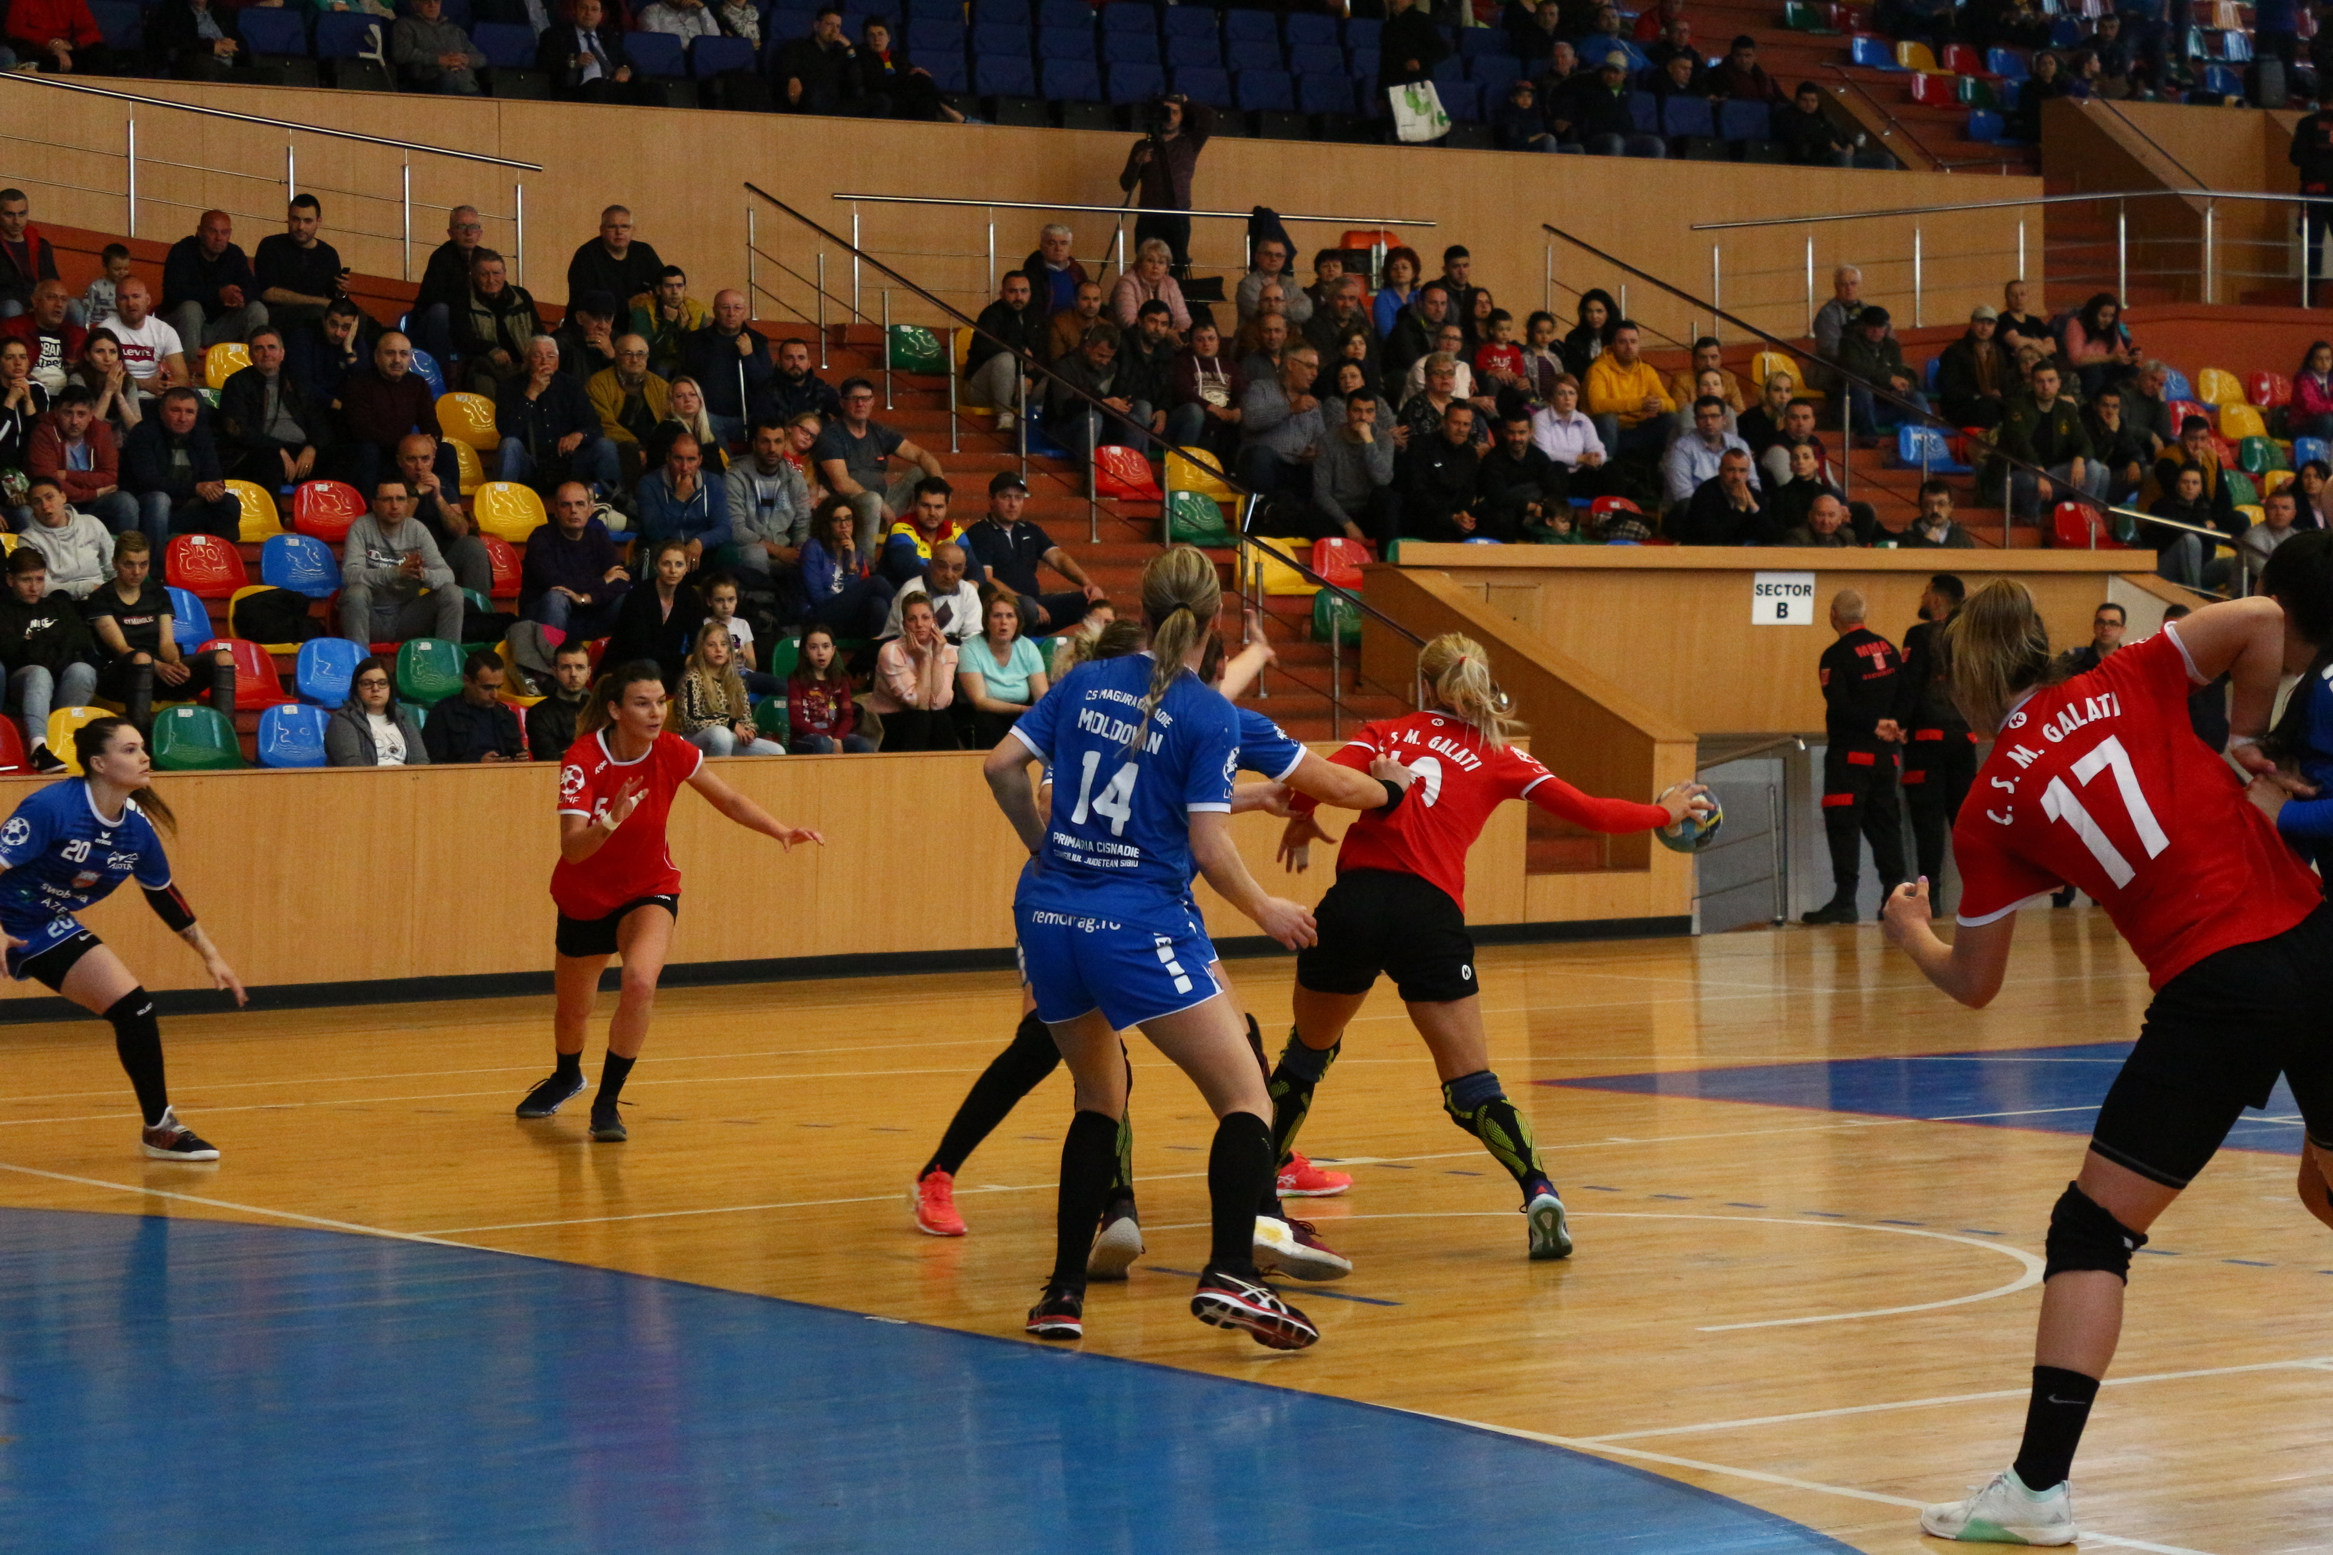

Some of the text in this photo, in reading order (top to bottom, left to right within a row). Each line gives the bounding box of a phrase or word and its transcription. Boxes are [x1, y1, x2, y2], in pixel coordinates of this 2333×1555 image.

[1755, 584, 1812, 597] SECTOR
[1776, 602, 1789, 619] B
[1085, 689, 1098, 701] CS
[1099, 688, 1138, 708] MAGURA
[2006, 744, 2045, 769] M.
[2042, 691, 2121, 743] GALATI
[1403, 729, 1421, 745] M.
[1428, 736, 1482, 772] GALATI
[1071, 751, 1139, 838] 14
[2040, 734, 2170, 889] 17
[60, 839, 91, 863] 20
[1053, 831, 1140, 858] PRIMARIA CISNADIE
